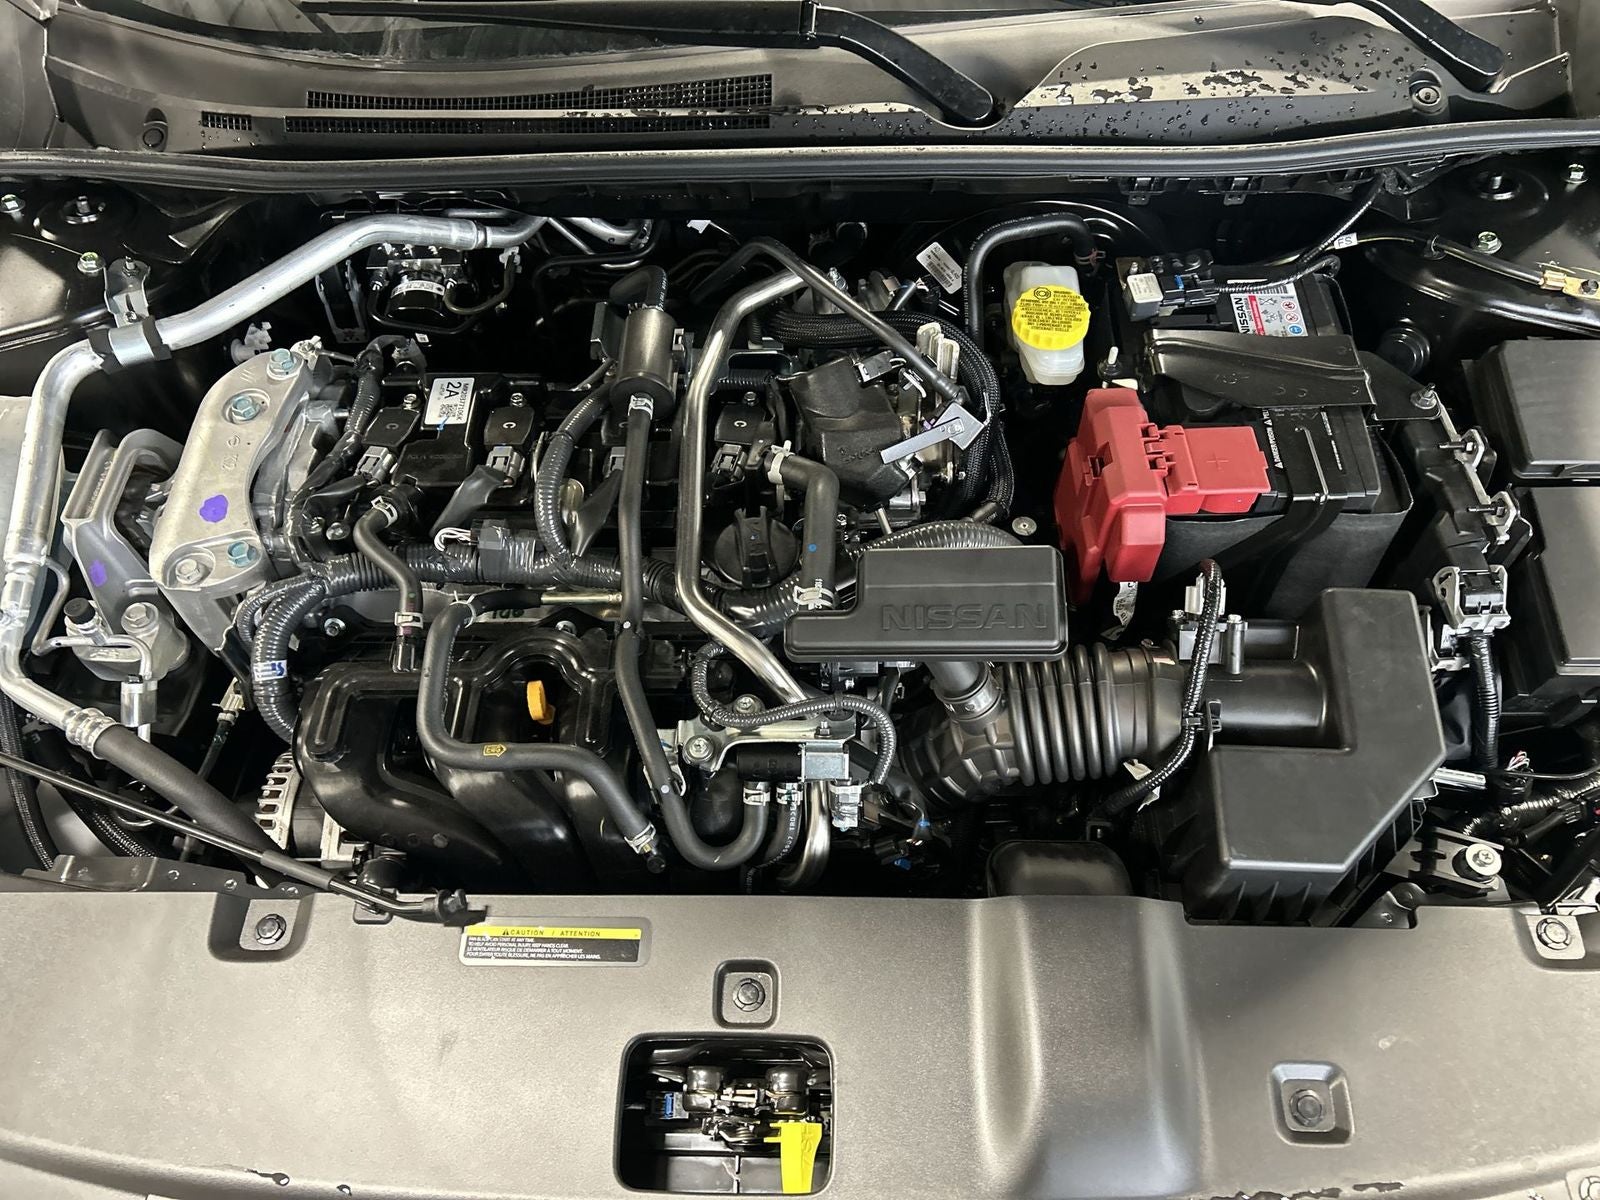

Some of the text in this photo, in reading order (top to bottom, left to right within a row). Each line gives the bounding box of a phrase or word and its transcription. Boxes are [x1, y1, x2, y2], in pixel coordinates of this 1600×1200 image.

[1337, 236, 1353, 247] FS
[1233, 297, 1251, 334] NISSAN
[444, 381, 463, 399] 2A
[502, 421, 517, 429] C
[733, 420, 748, 428] C
[882, 604, 1048, 631] NISSAN
